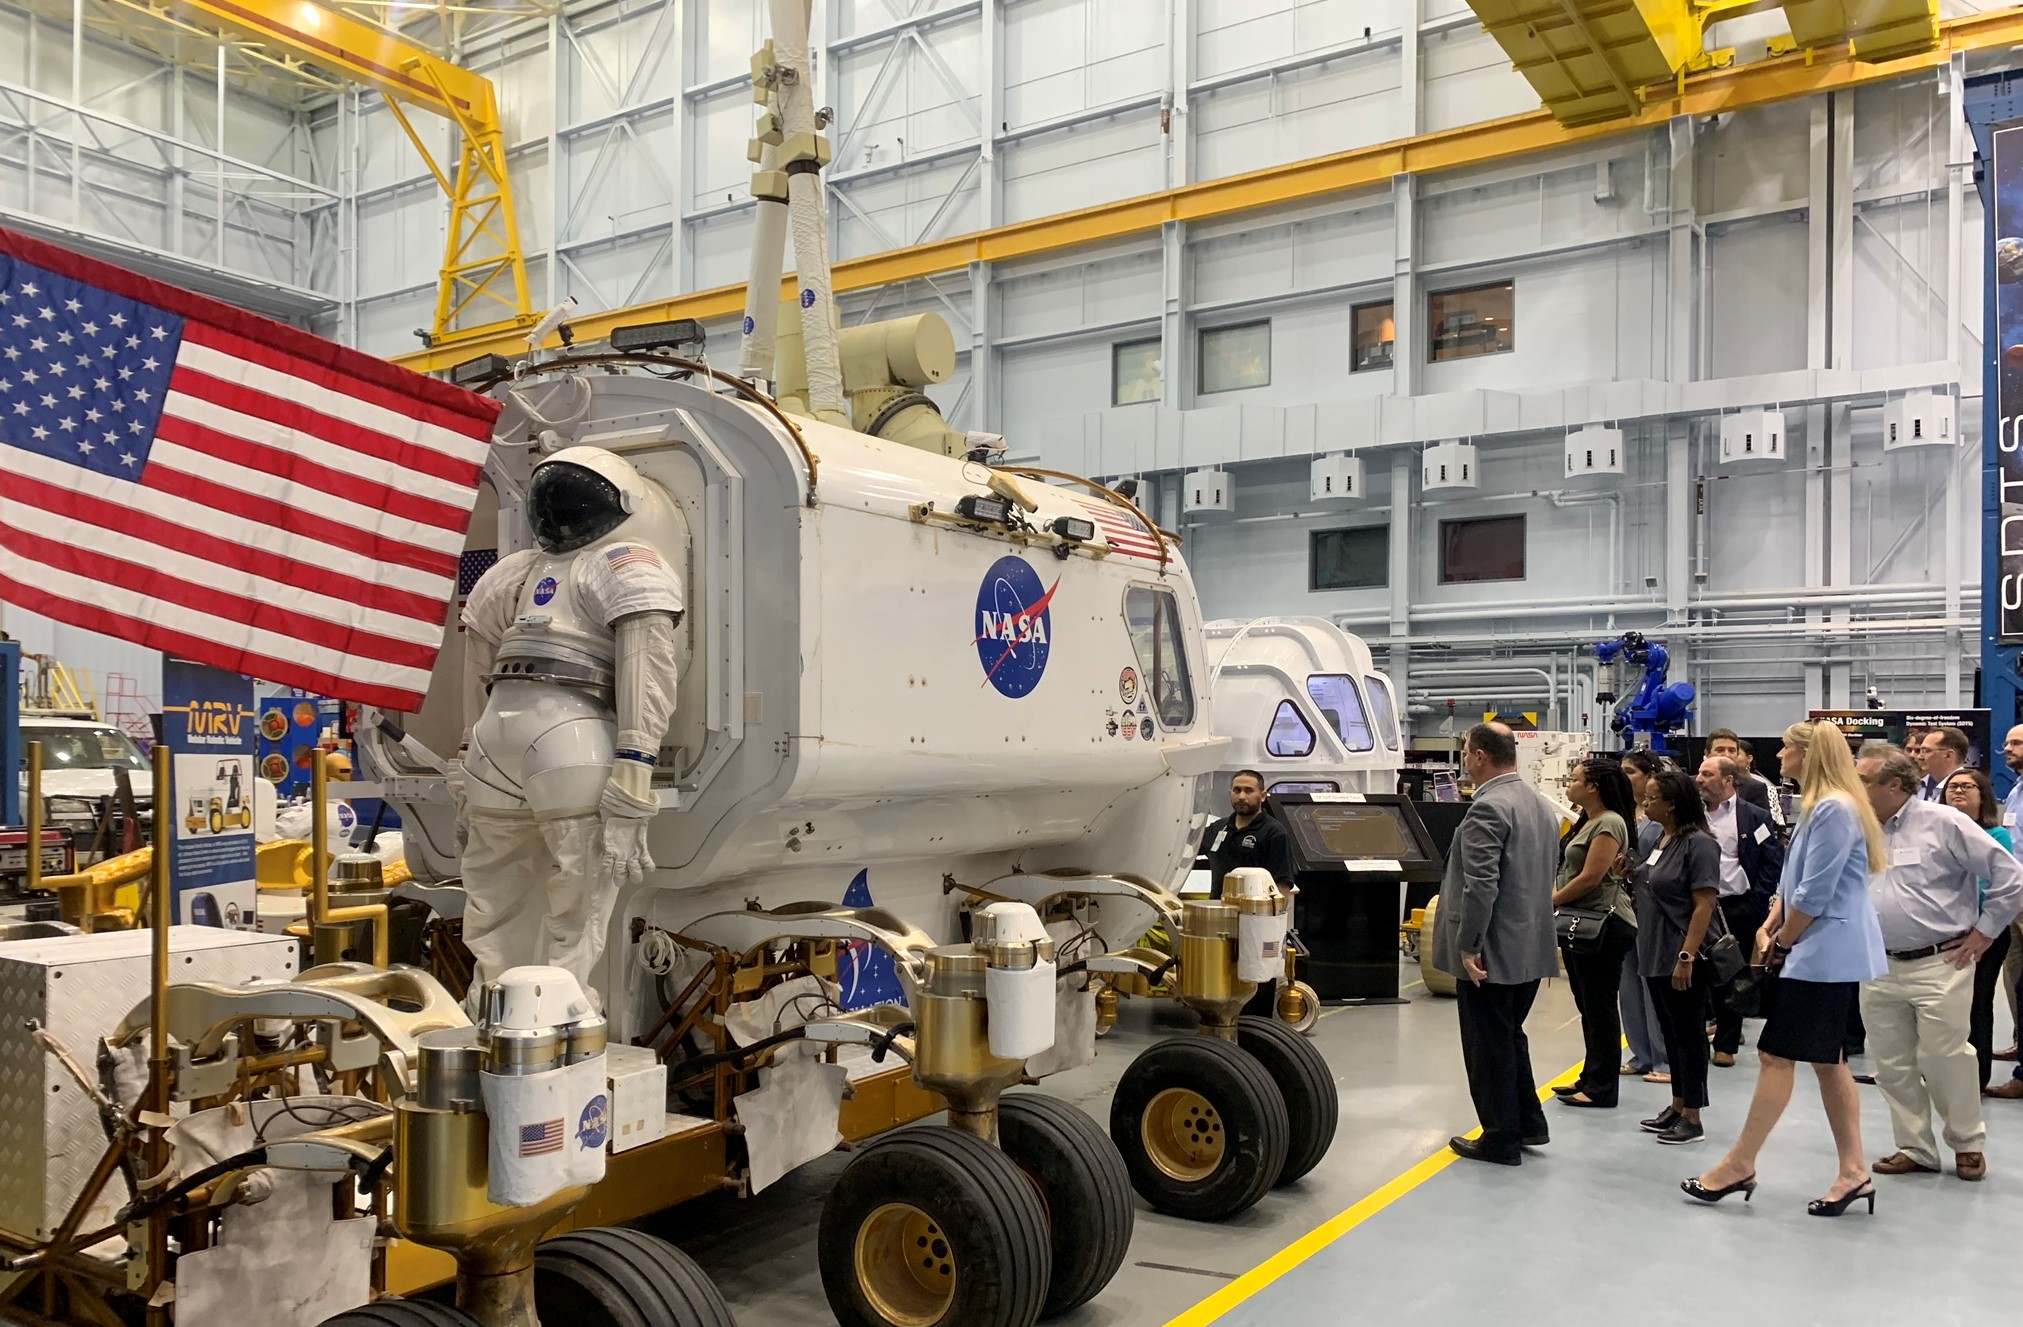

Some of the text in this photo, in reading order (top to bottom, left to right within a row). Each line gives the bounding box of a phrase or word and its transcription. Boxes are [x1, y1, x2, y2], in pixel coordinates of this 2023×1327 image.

[535, 587, 554, 595] NASA
[982, 611, 1048, 644] NASA
[187, 700, 242, 735] MRV
[1846, 717, 1884, 727] Docking
